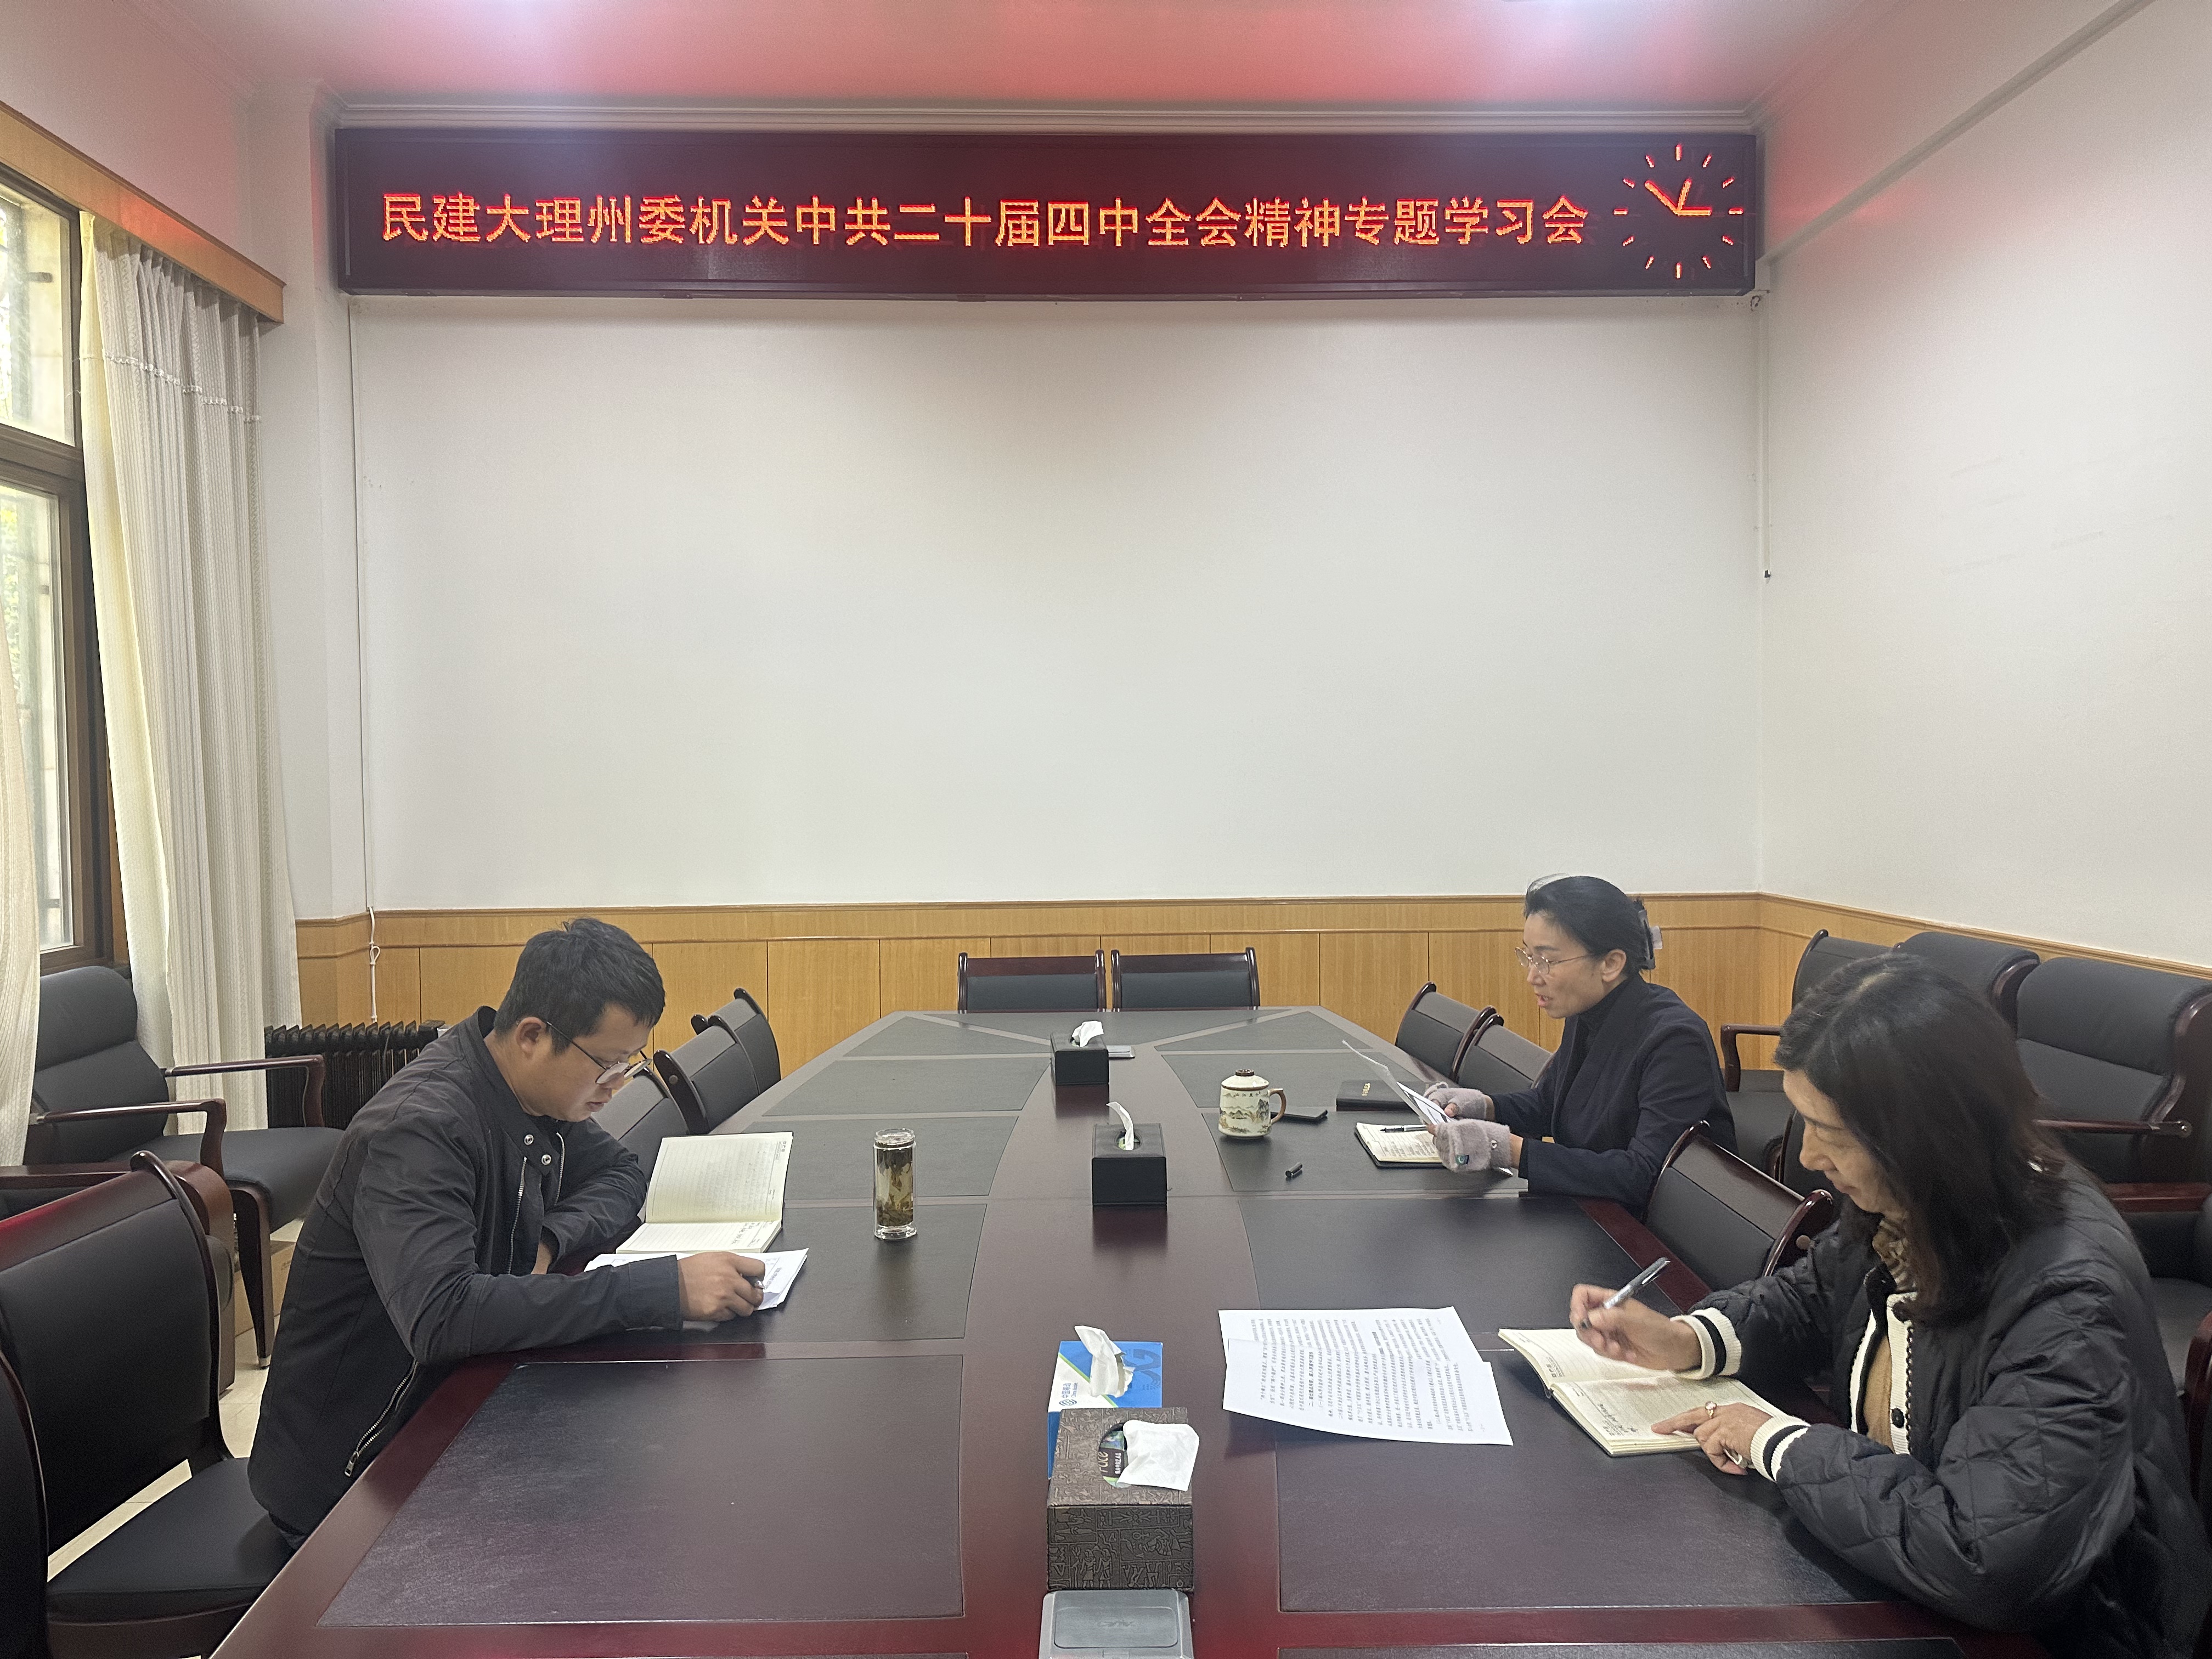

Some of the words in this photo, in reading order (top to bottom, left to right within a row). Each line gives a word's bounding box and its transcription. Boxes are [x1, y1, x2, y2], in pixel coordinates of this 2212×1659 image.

[382, 191, 1589, 248] 民建大理州委机关中共二十届四中全会精神专题学习会
